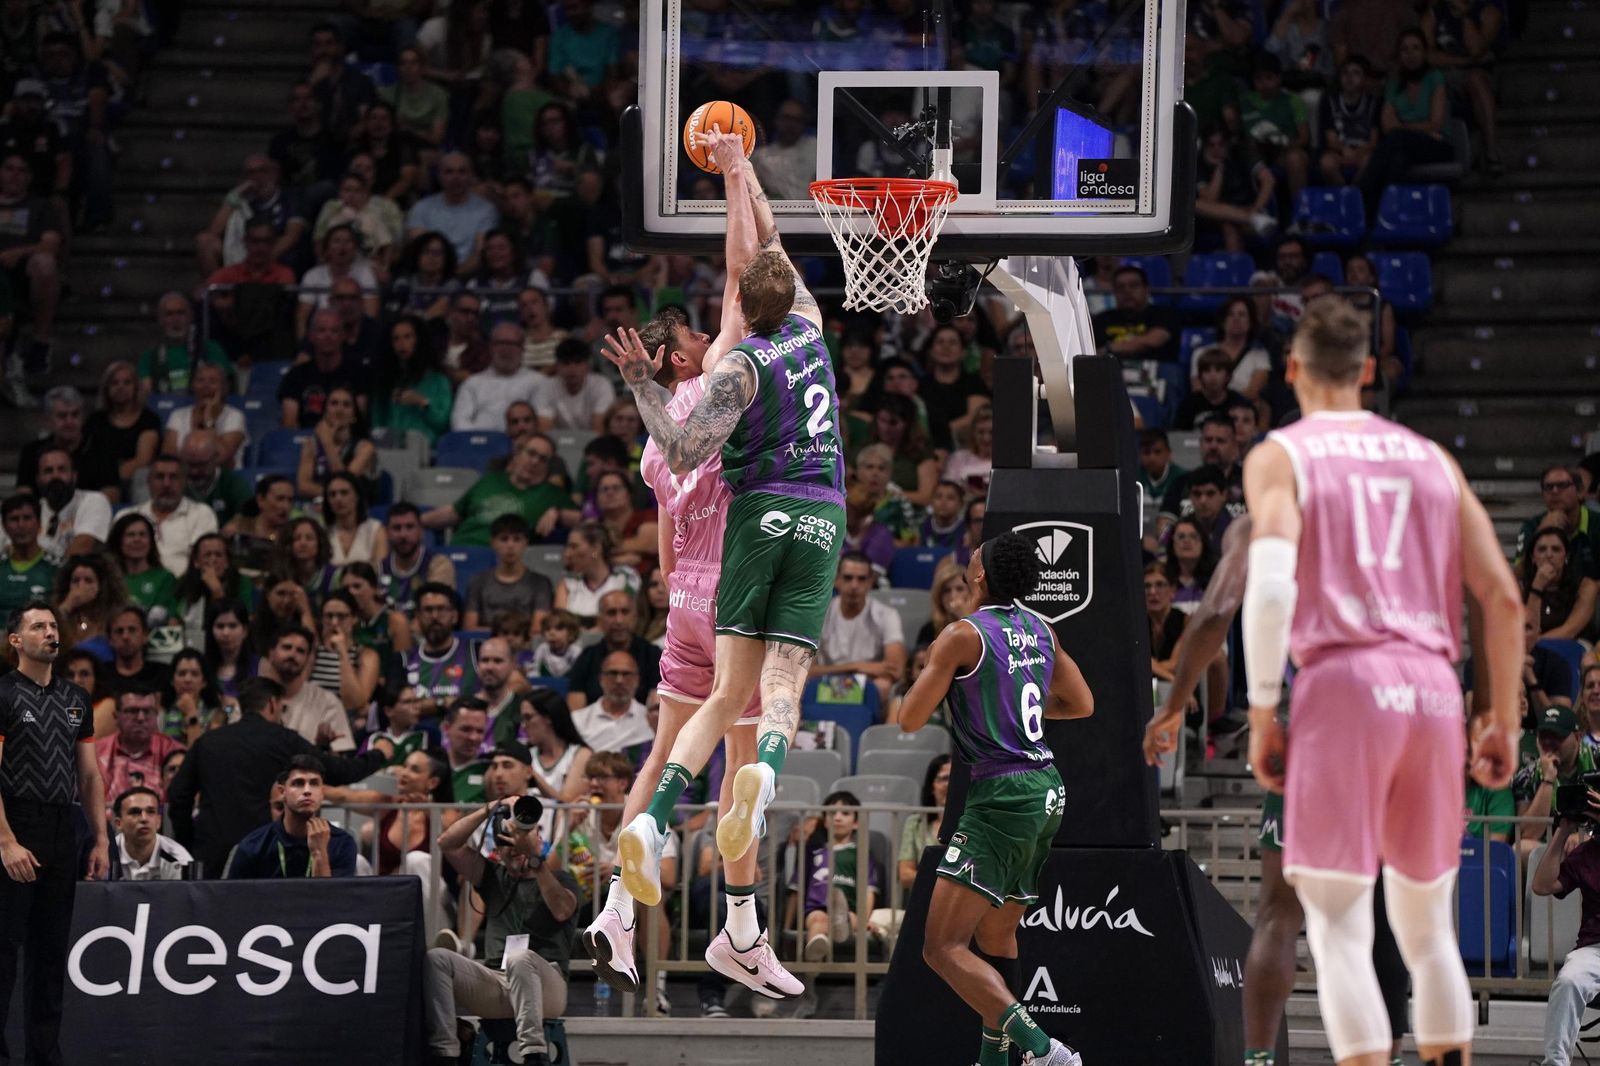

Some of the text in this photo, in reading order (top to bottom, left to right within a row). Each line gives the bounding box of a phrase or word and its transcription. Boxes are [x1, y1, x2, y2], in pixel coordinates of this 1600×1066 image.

[1080, 170, 1105, 184] liga
[1080, 183, 1134, 195] endesa
[804, 383, 833, 438] 2
[799, 514, 837, 536] COSTA
[1348, 473, 1413, 571] 17
[793, 532, 831, 553] MÁLAGA
[796, 523, 833, 545] DEL SOL
[1038, 568, 1080, 580] ndación
[1002, 627, 1038, 652] Taylor
[1020, 682, 1043, 742] 6
[1019, 884, 1156, 937] alucía
[67, 903, 382, 996] desa
[1028, 1004, 1039, 1013] de
[1040, 1003, 1082, 1014] Andalucía
